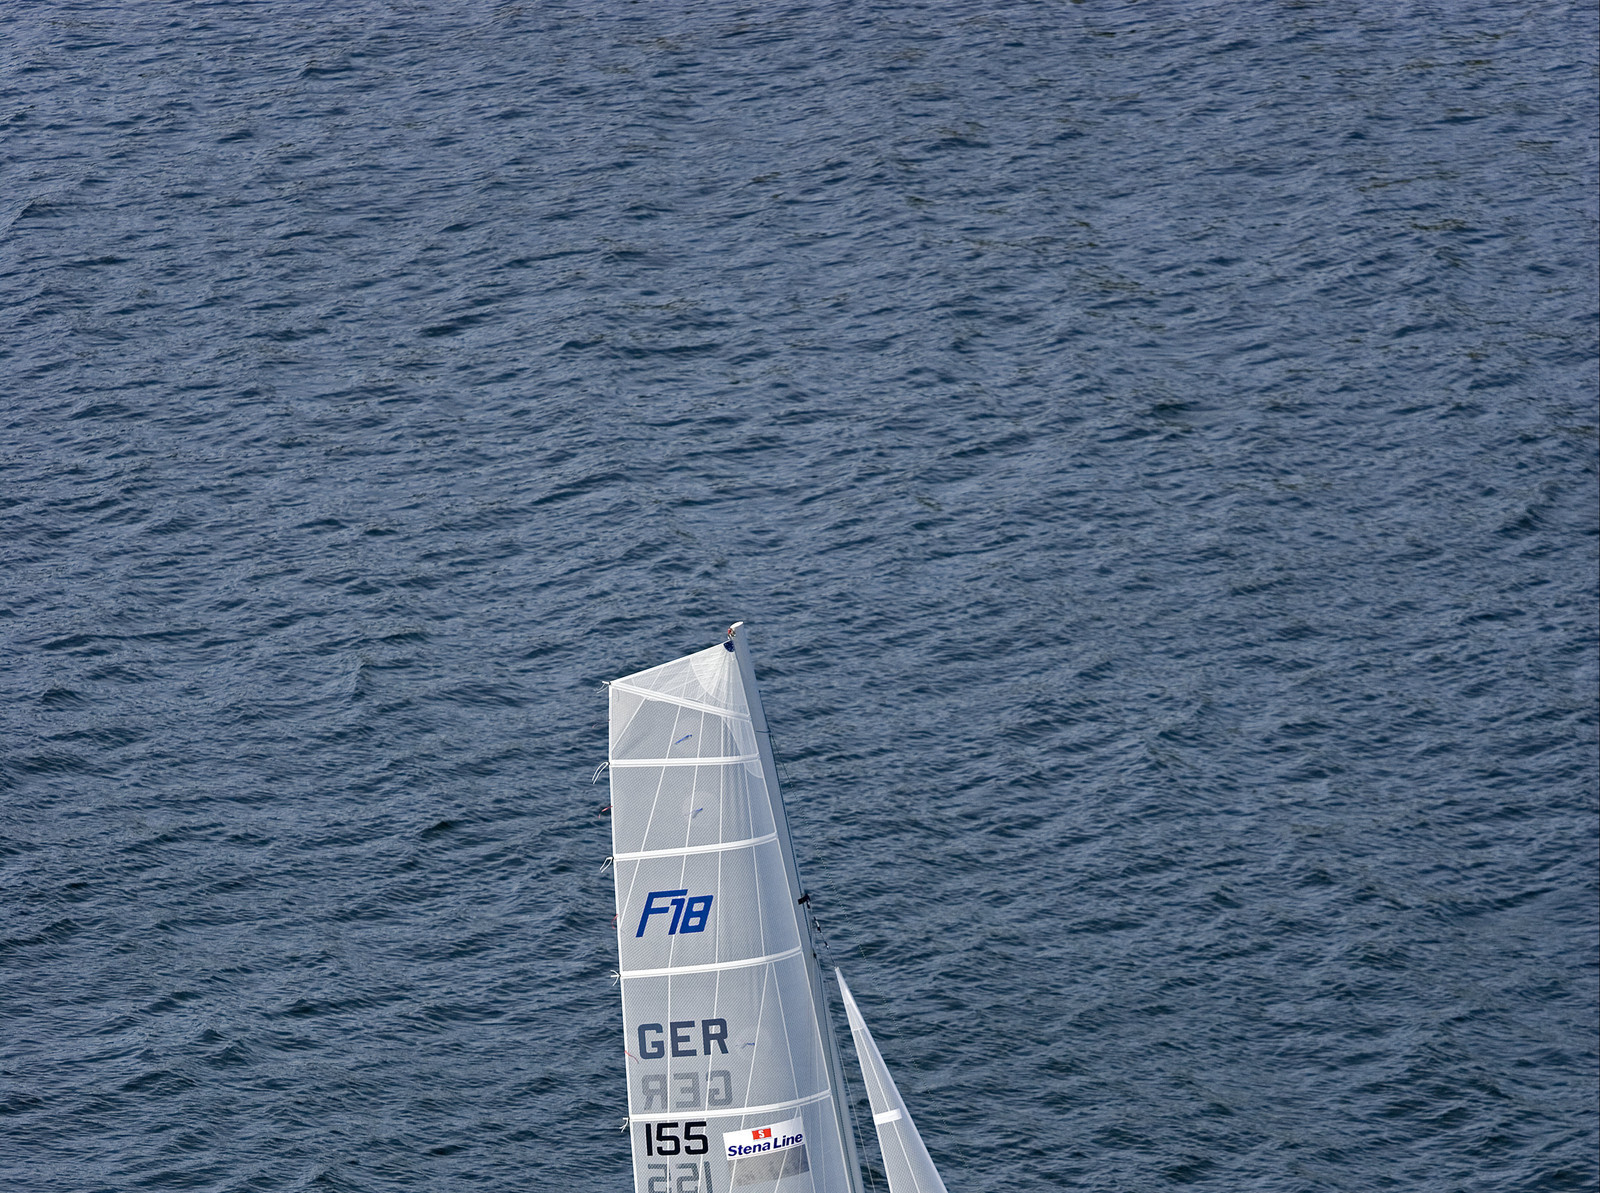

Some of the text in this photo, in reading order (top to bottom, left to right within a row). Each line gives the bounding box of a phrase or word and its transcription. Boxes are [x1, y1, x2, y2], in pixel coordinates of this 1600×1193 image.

[636, 889, 713, 937] F18
[638, 1018, 728, 1059] GER
[645, 1121, 709, 1156] 155
[728, 1133, 803, 1157] Stena Line
